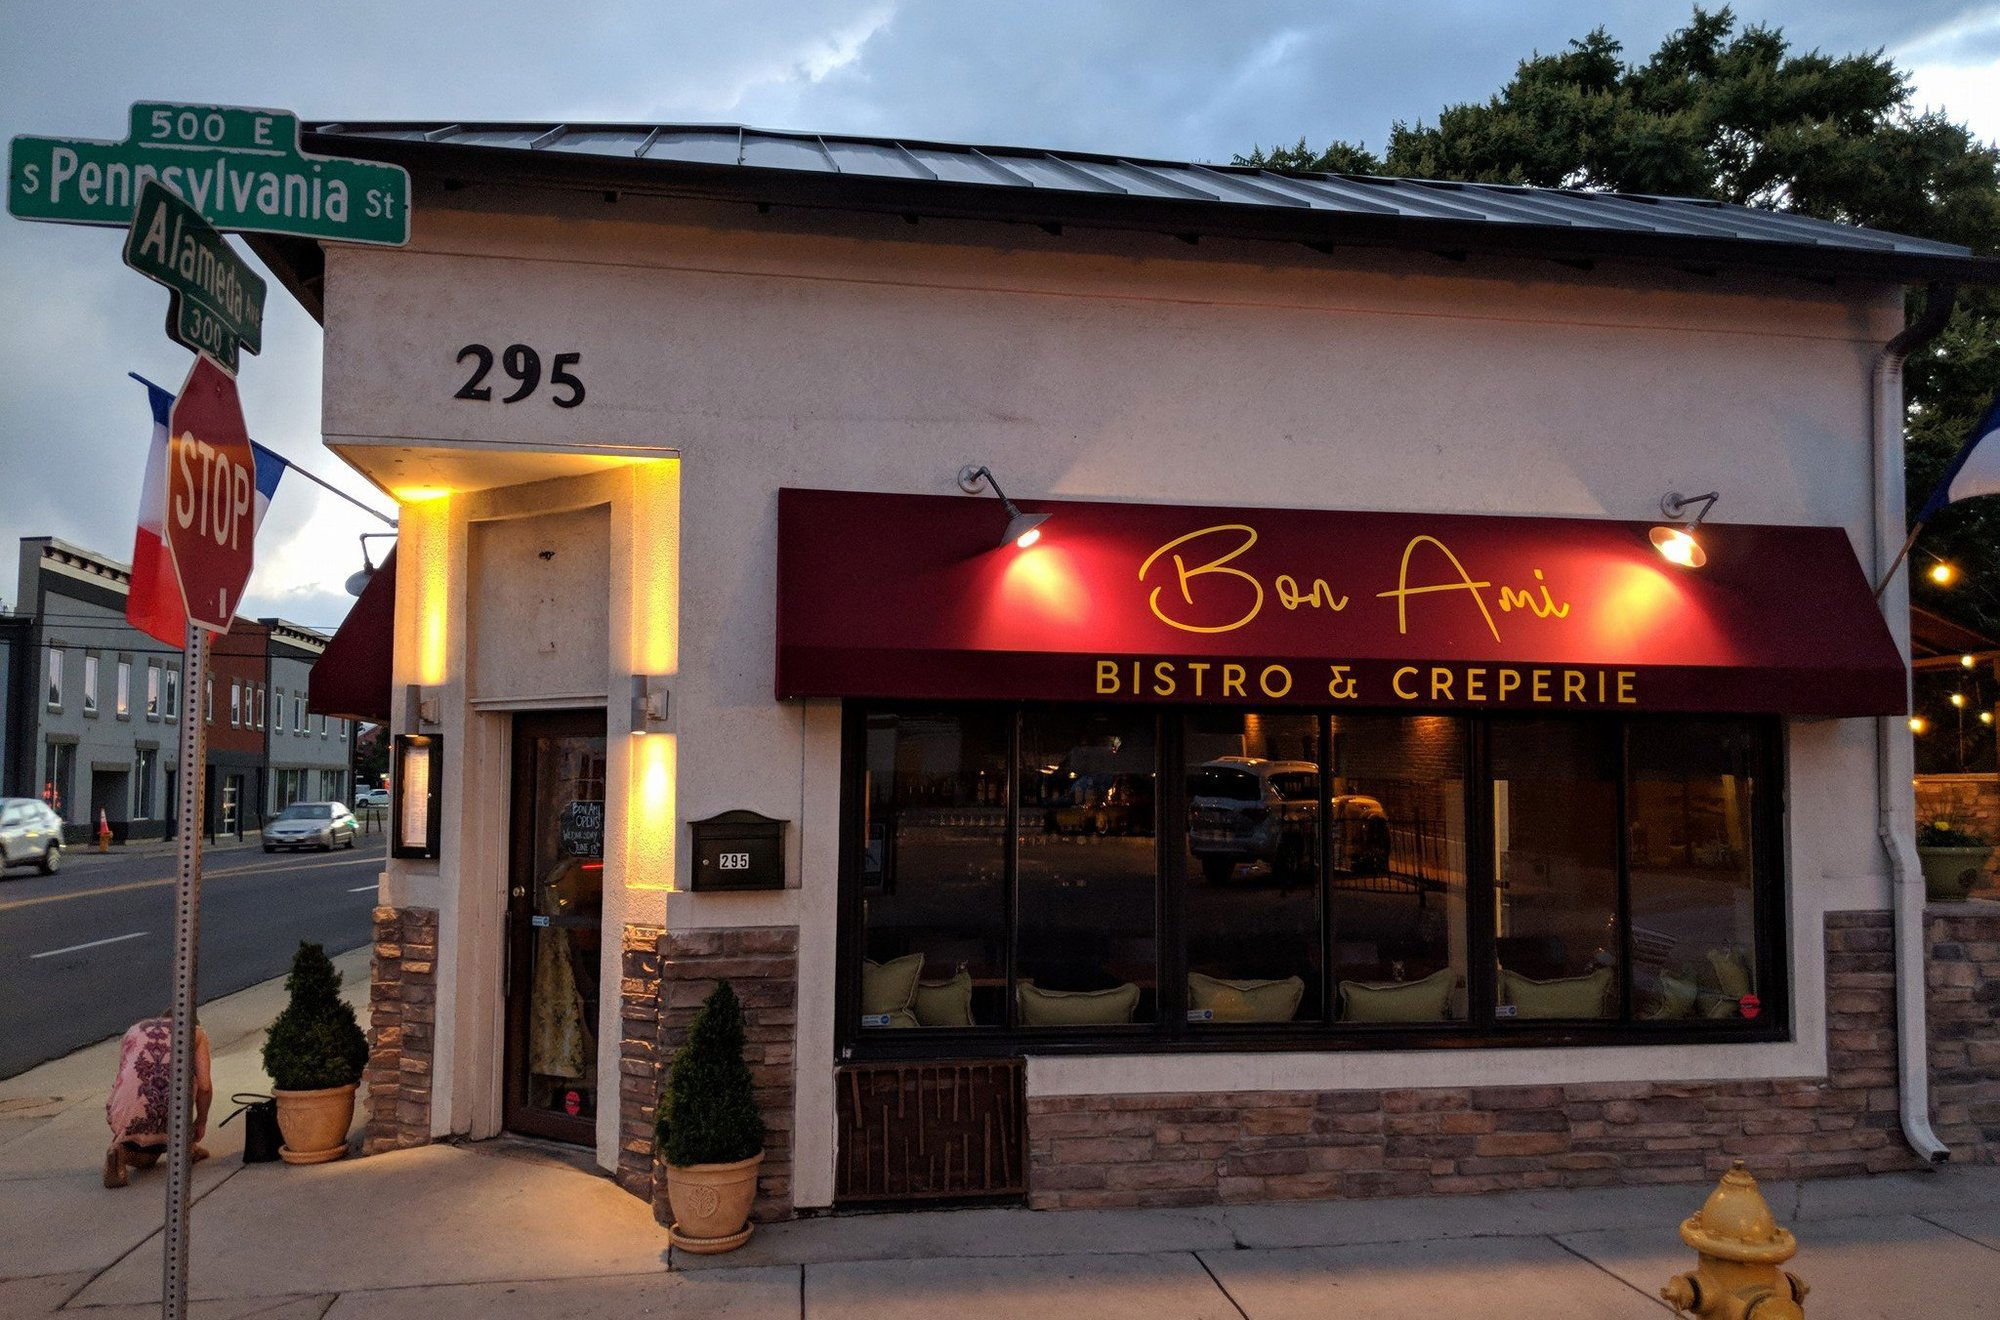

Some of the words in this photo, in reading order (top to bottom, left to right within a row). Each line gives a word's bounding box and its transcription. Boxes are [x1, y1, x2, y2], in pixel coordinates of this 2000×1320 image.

[151, 110, 226, 142] 500
[254, 117, 273, 146] E
[21, 163, 40, 194] S
[50, 146, 349, 223] Pennsylvania
[365, 188, 395, 219] St
[139, 200, 243, 325] Alameda
[190, 308, 222, 351] 300
[228, 336, 236, 365] S
[453, 343, 586, 408] 295
[176, 431, 250, 550] STOP
[1138, 523, 1350, 634] Bon
[1375, 534, 1571, 643] Ami
[1096, 660, 1294, 699] BISTRO
[1328, 665, 1358, 699] &
[1392, 665, 1637, 704] CREPERIE
[721, 854, 747, 868] 295
